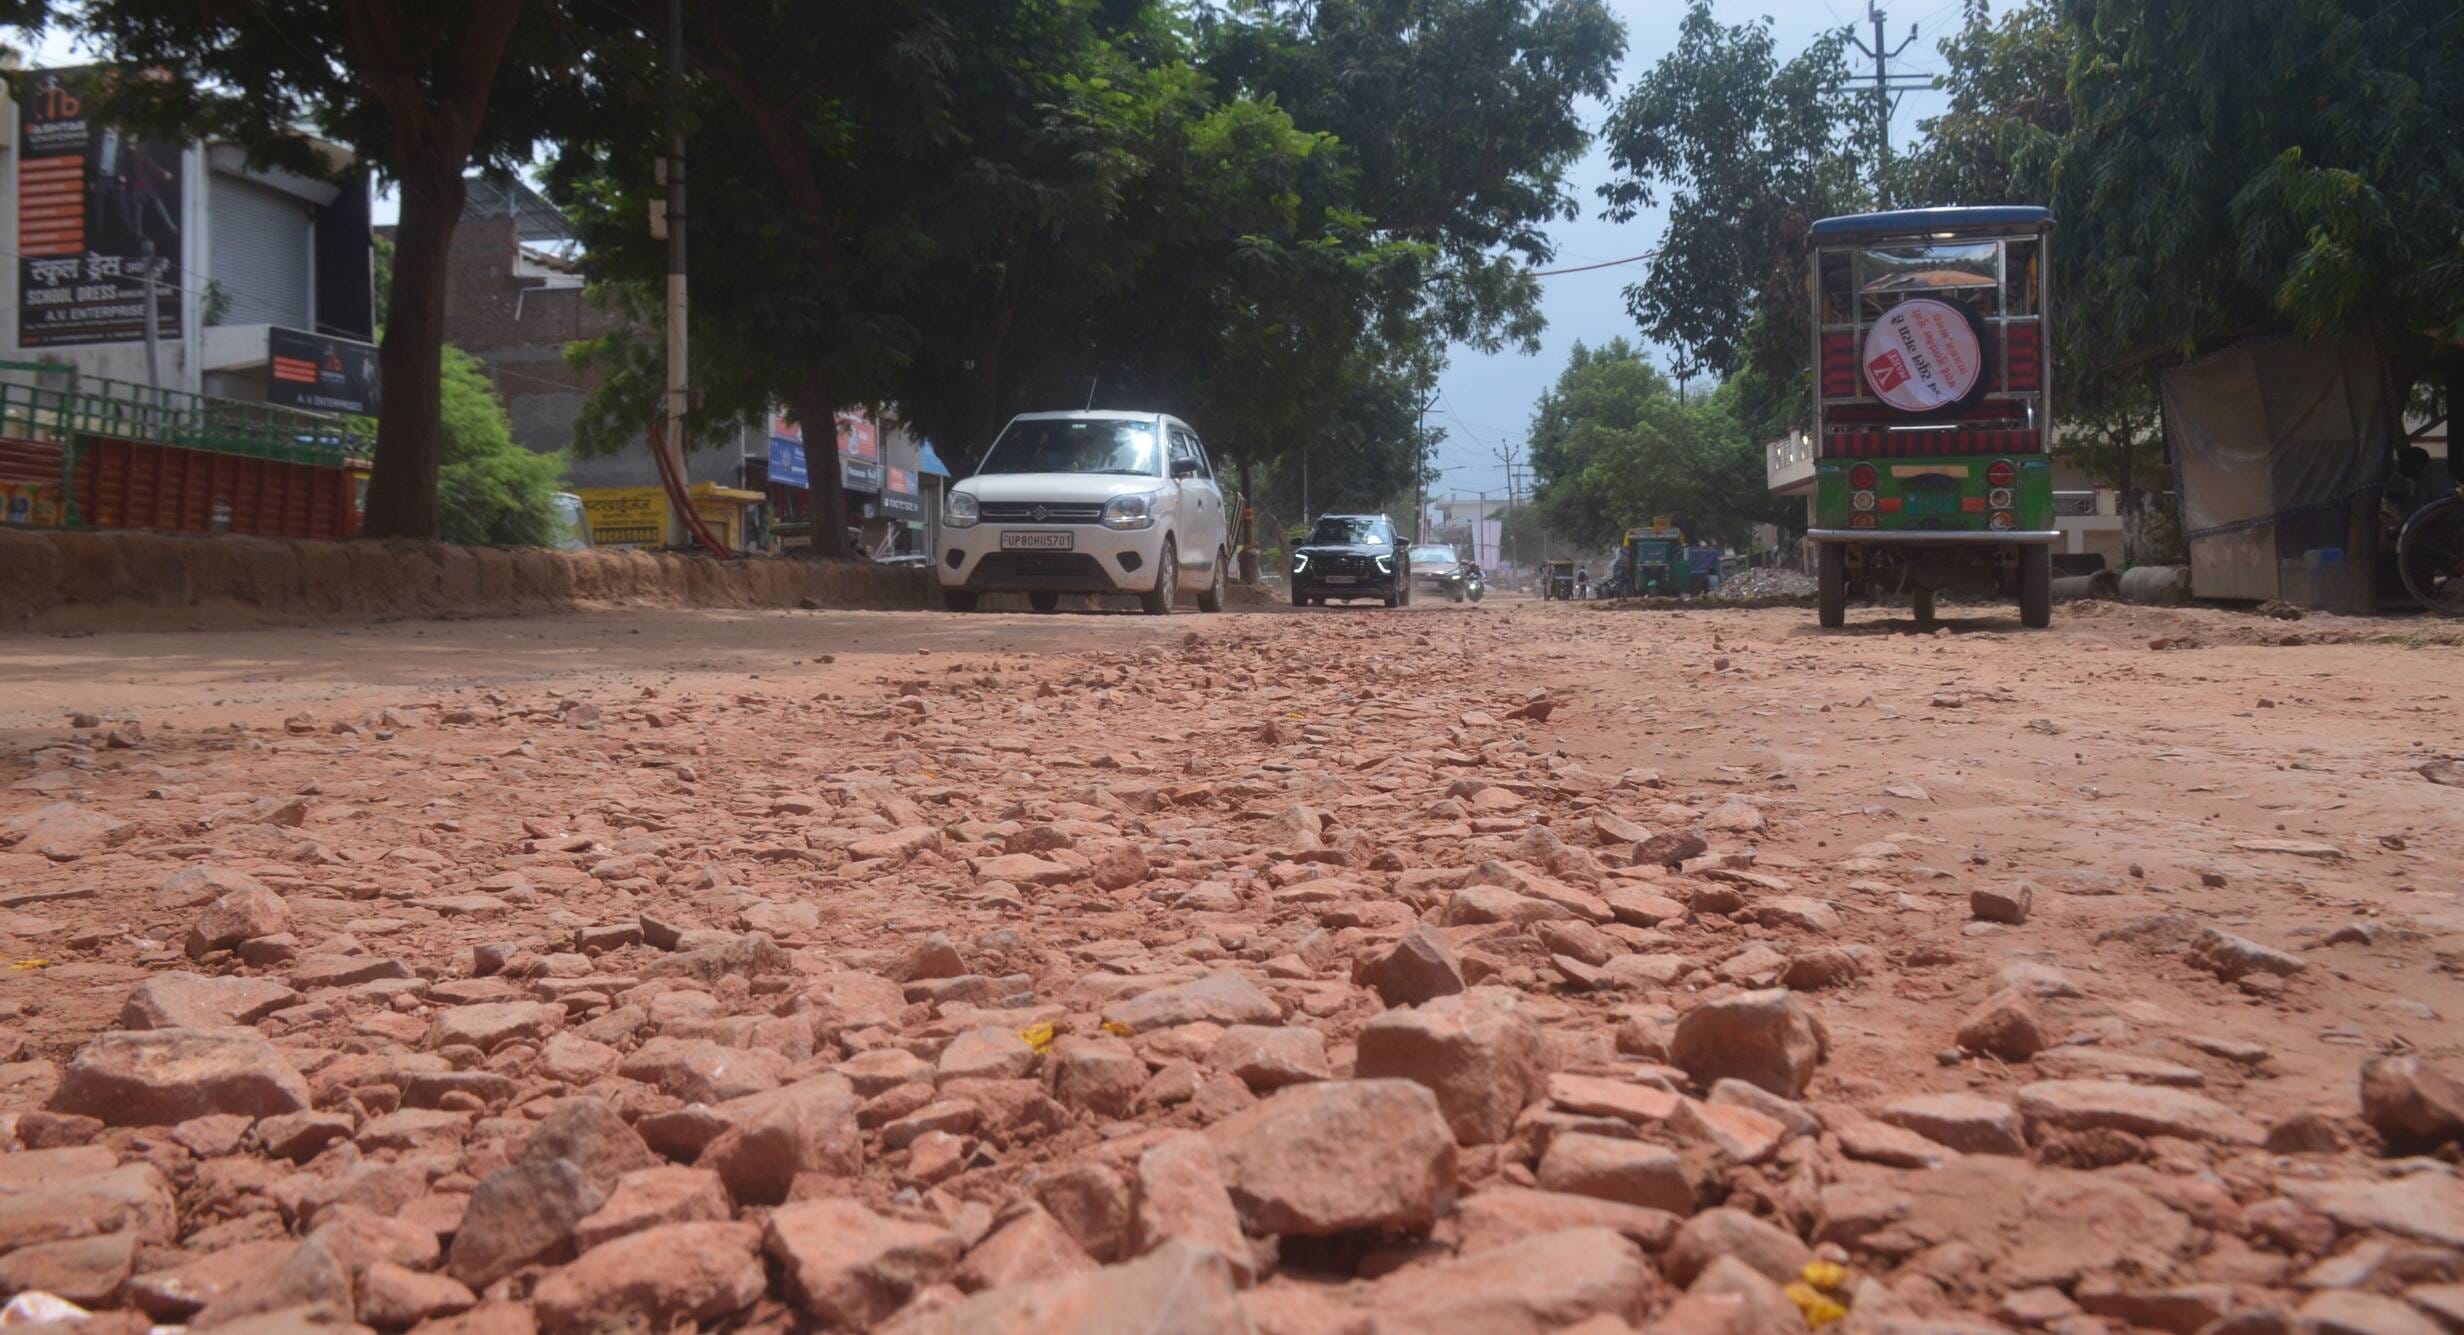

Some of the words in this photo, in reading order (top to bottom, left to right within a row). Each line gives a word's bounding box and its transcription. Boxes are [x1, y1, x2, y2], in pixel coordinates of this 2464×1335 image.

[30, 259, 80, 286] स्कूल
[86, 251, 122, 281] ड्रेस
[26, 288, 73, 305] SCHOOL
[76, 285, 117, 302] DRESS
[1890, 313, 1904, 326] है
[1898, 325, 1918, 352] गया
[1873, 366, 1894, 384] V
[1888, 351, 1907, 380] MART
[1911, 352, 1933, 380] खुल
[1008, 535, 1070, 546] UP80HU5701
